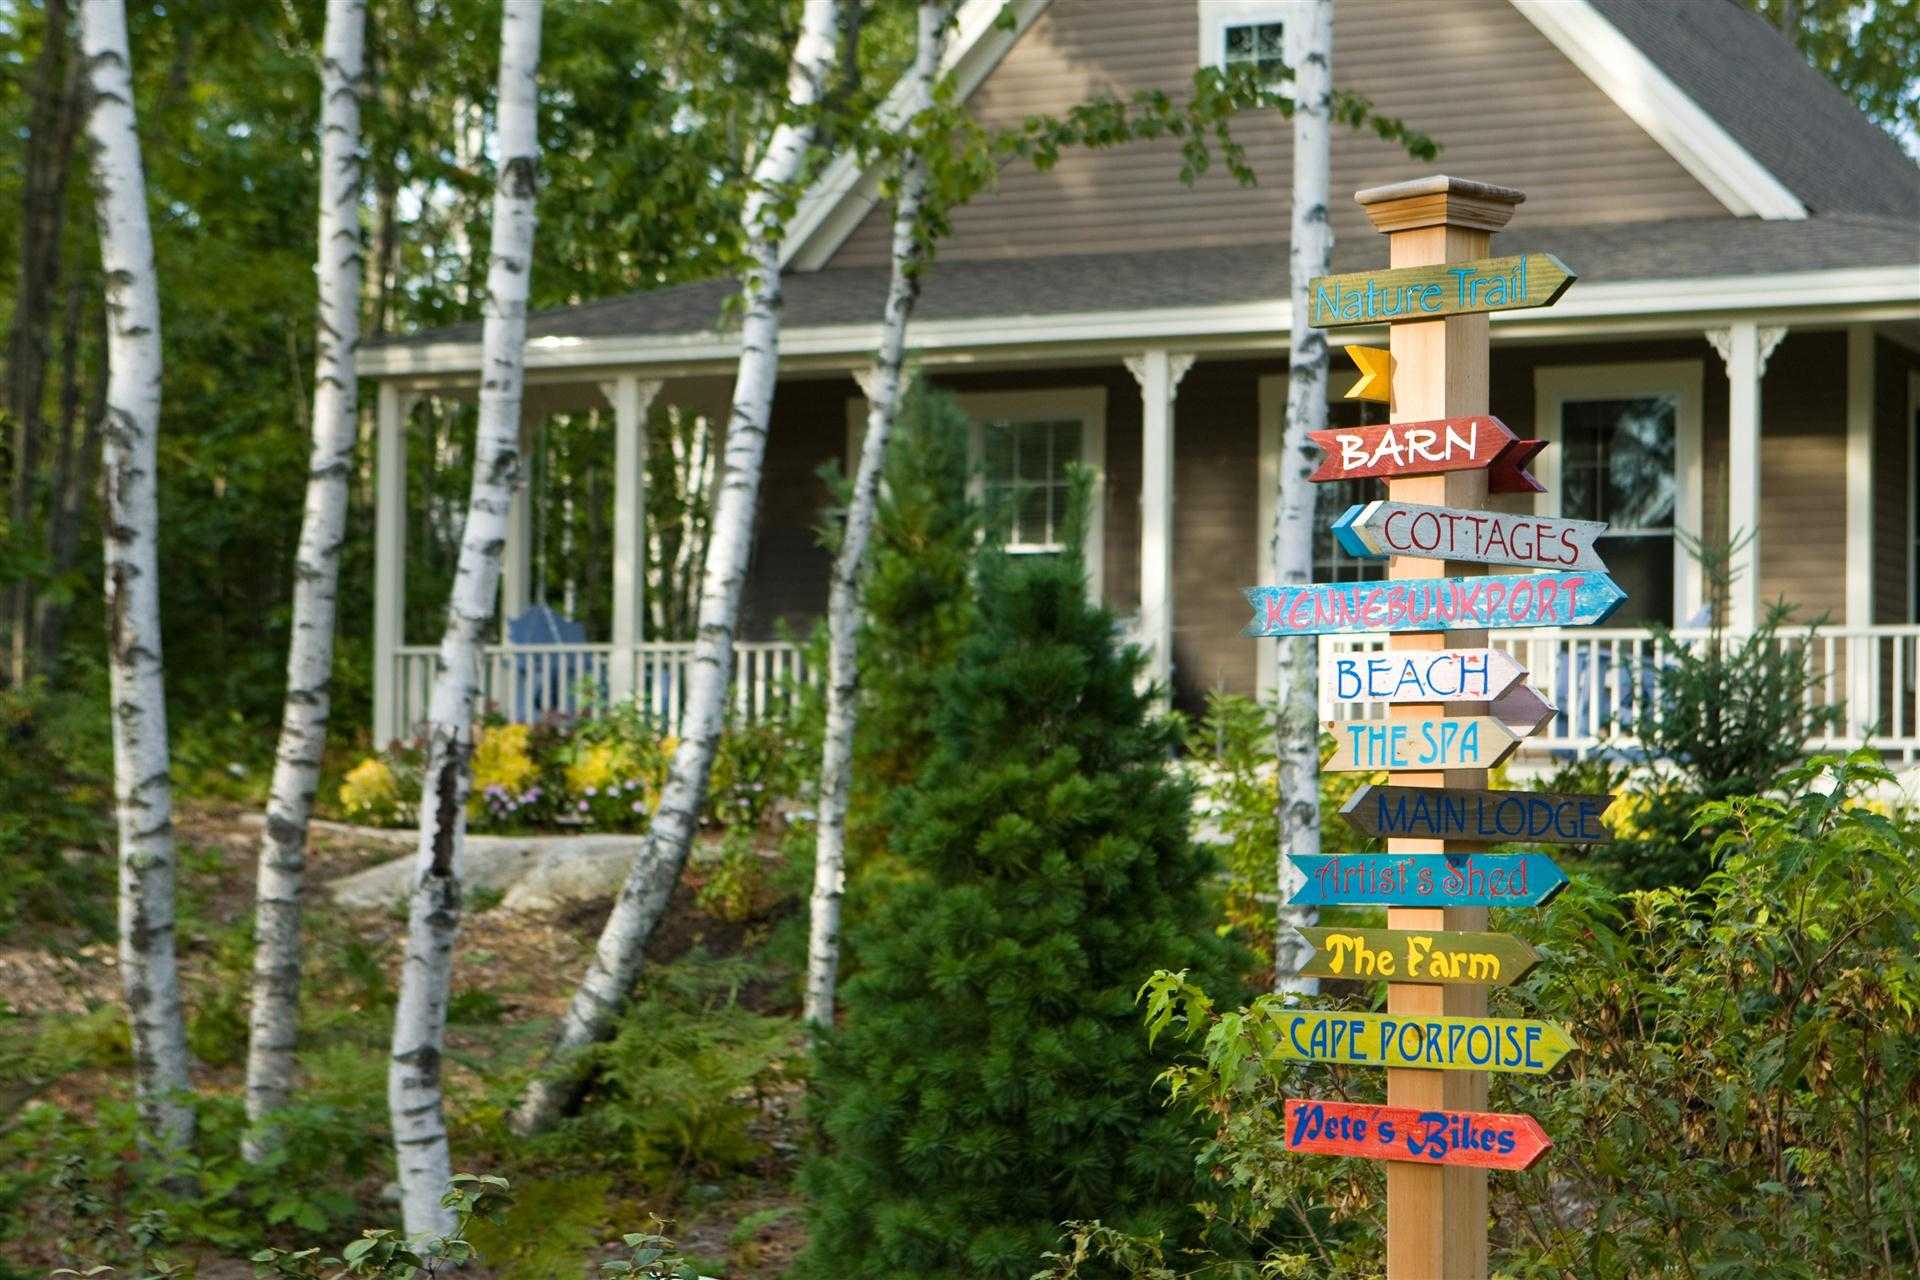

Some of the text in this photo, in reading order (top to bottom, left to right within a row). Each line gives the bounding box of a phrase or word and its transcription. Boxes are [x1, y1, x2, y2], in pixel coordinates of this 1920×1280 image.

[1314, 255, 1527, 321] Nature Trail
[1336, 422, 1477, 470] BARN
[1384, 511, 1579, 565] COTTAGES
[1265, 577, 1585, 631] KENNEBUNKPORT
[1337, 654, 1488, 698] BEACH
[1347, 721, 1478, 768] THE SPA
[1377, 793, 1601, 840] MAIN LODGE
[1314, 858, 1528, 897] Artist's Shed
[1325, 934, 1500, 980] The Farm
[1290, 1018, 1543, 1068] CAPE PORPOISE
[1289, 1104, 1516, 1158] Pete's Bikes
